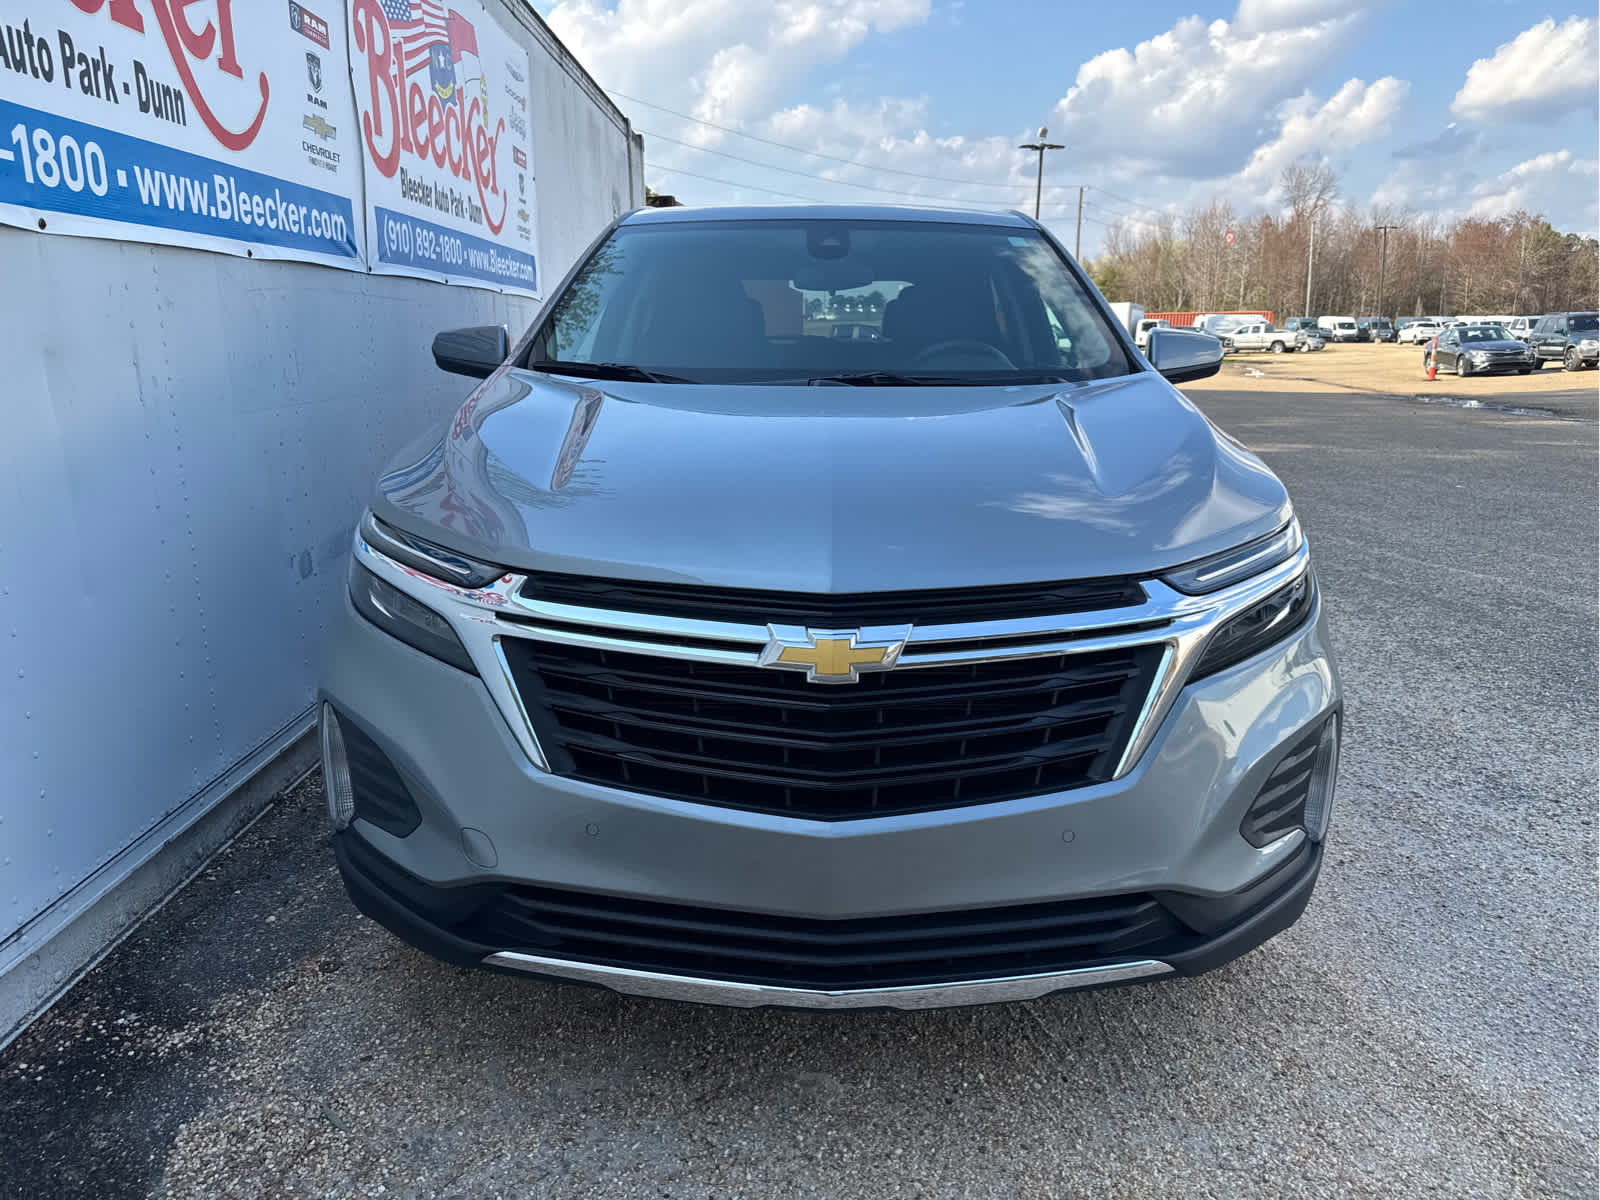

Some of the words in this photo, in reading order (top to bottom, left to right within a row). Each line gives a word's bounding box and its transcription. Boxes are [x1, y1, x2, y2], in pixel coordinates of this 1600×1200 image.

[303, 13, 327, 36] RAM
[57, 29, 119, 105] Park
[133, 59, 187, 127] Dunn
[307, 93, 328, 110] RAM
[353, 0, 507, 236] Bleecker
[302, 140, 340, 163] CHEVROLET
[134, 165, 347, 242] www.Bleecker.com
[400, 166, 432, 208] Bleecker
[434, 181, 449, 214] Auto
[450, 187, 465, 219] Park
[468, 195, 483, 225] Dunn
[384, 214, 414, 263] (910)
[415, 227, 463, 265] 892-1800
[468, 247, 534, 282] www.Bleecker.com
